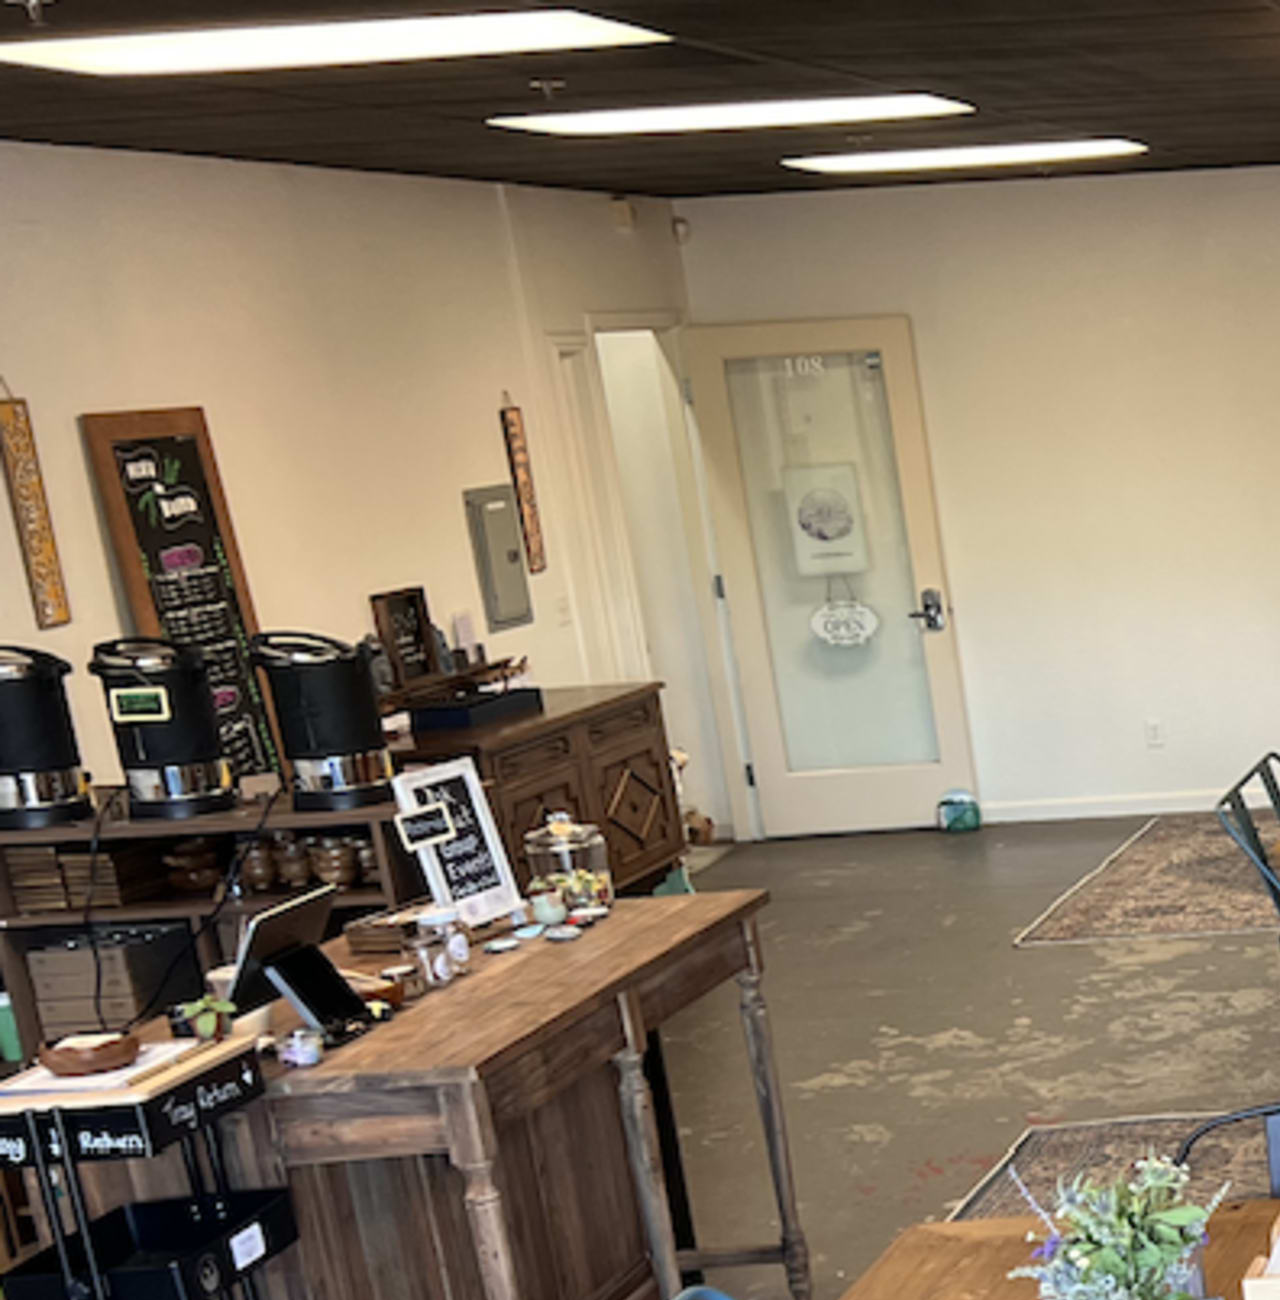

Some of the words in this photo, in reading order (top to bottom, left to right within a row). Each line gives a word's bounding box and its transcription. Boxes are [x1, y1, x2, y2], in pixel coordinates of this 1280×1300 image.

[784, 356, 824, 378] 108
[823, 619, 866, 634] OPEN
[196, 1081, 242, 1110] Return
[78, 1130, 146, 1154] Return
